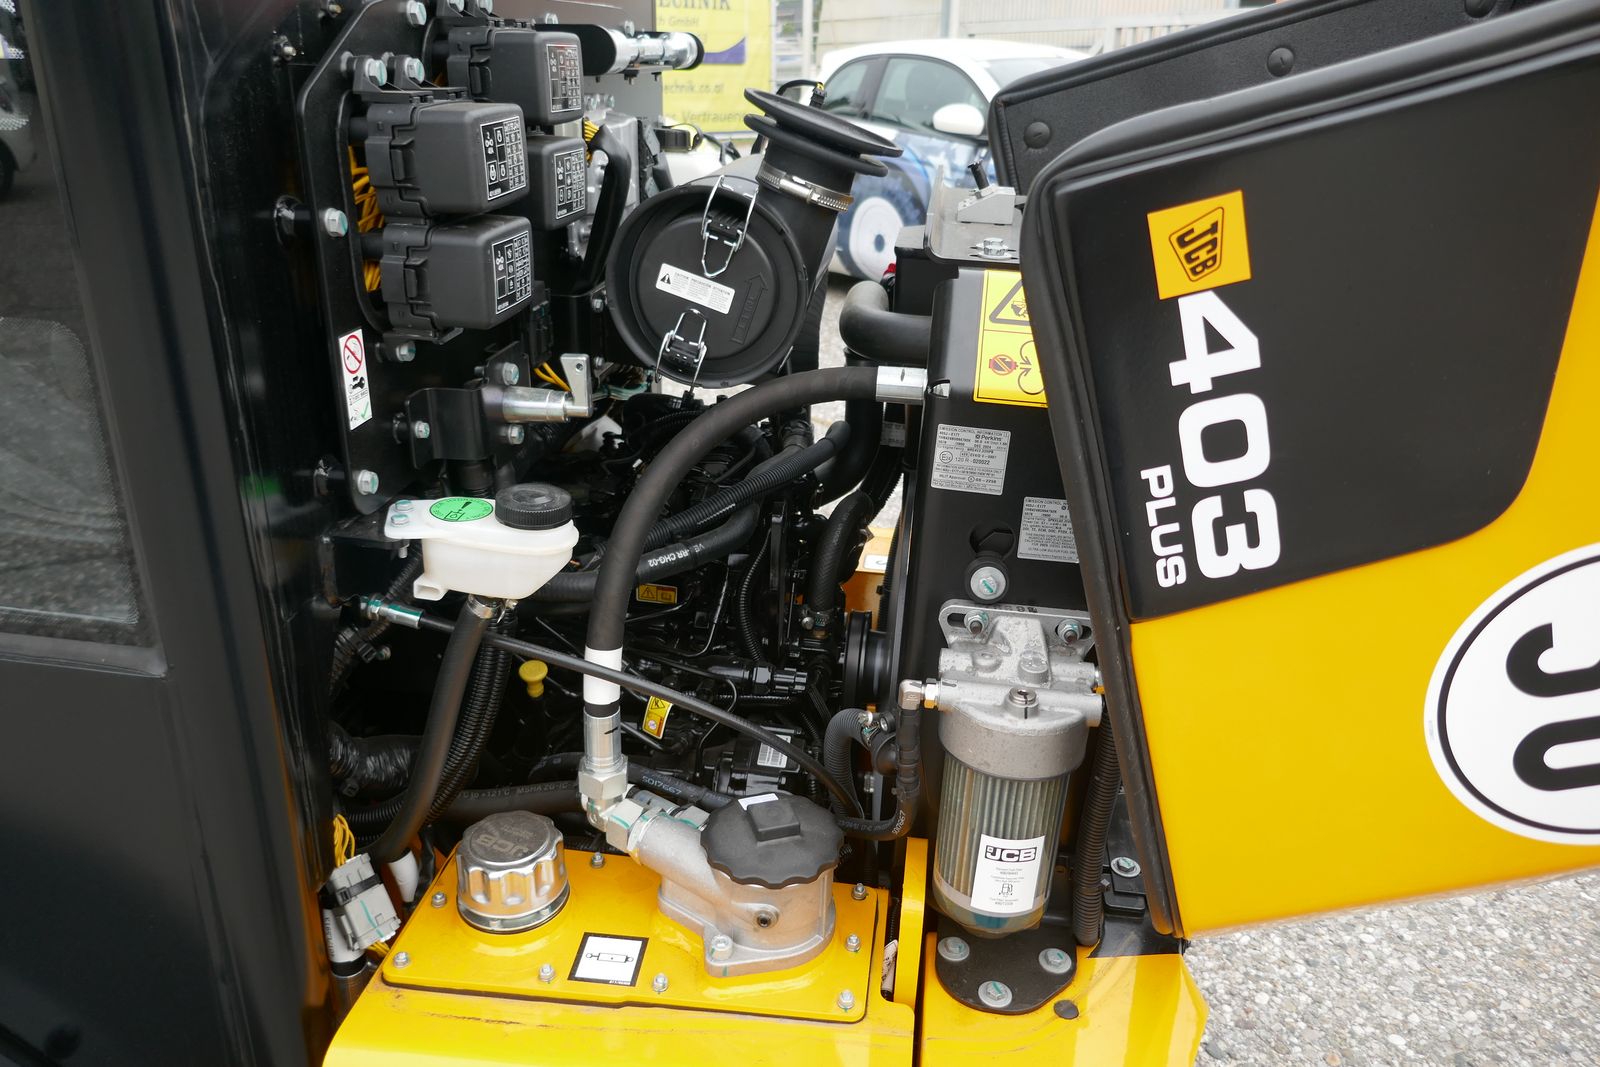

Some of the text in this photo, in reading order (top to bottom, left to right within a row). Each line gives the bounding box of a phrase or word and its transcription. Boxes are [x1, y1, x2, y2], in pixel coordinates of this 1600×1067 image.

[659, 0, 730, 10] ECHNIK
[668, 16, 700, 26] GmbH
[664, 80, 724, 94] echnik.co.at
[1176, 221, 1219, 276] JCB
[1168, 290, 1281, 580] 403
[1140, 464, 1187, 588] PLUS
[985, 845, 1037, 862] JCB
